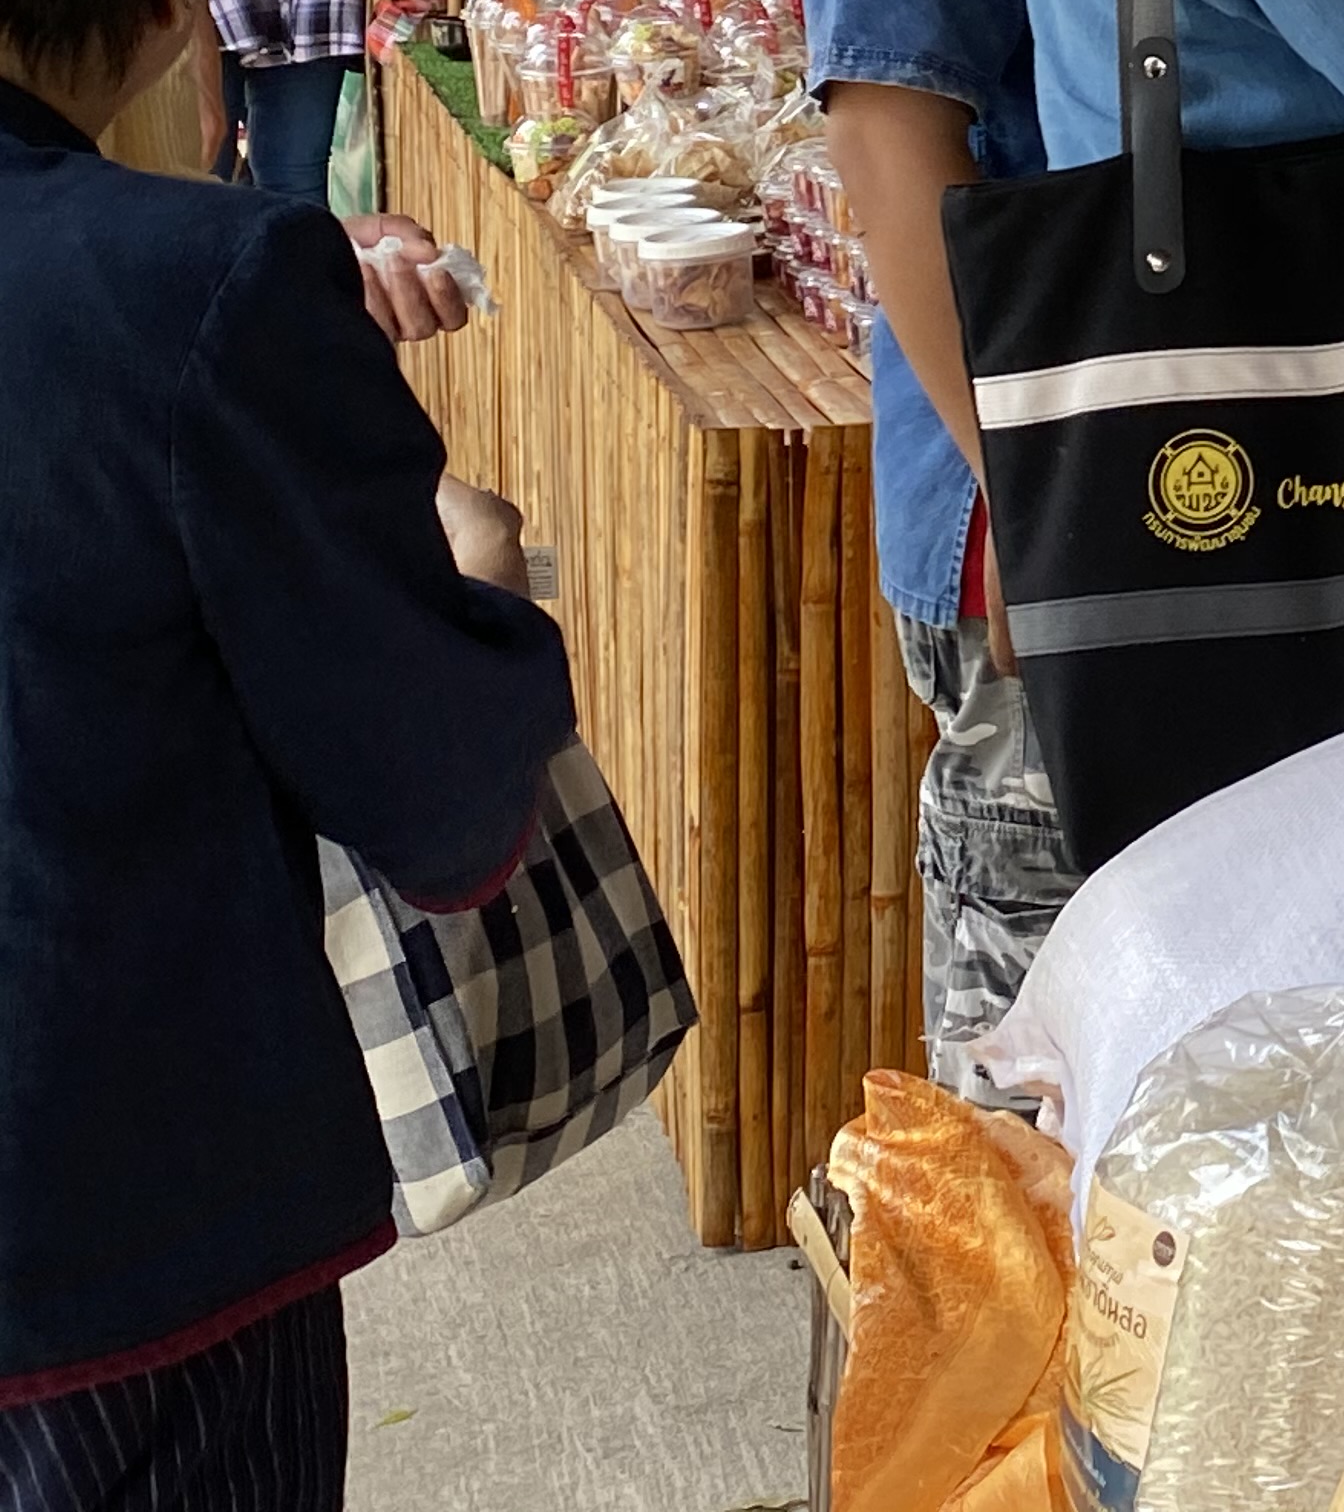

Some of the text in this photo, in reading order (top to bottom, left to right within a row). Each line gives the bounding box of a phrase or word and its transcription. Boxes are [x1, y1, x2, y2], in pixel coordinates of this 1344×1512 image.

[1141, 506, 1263, 553] กรมการพัฒนาชุมชน
